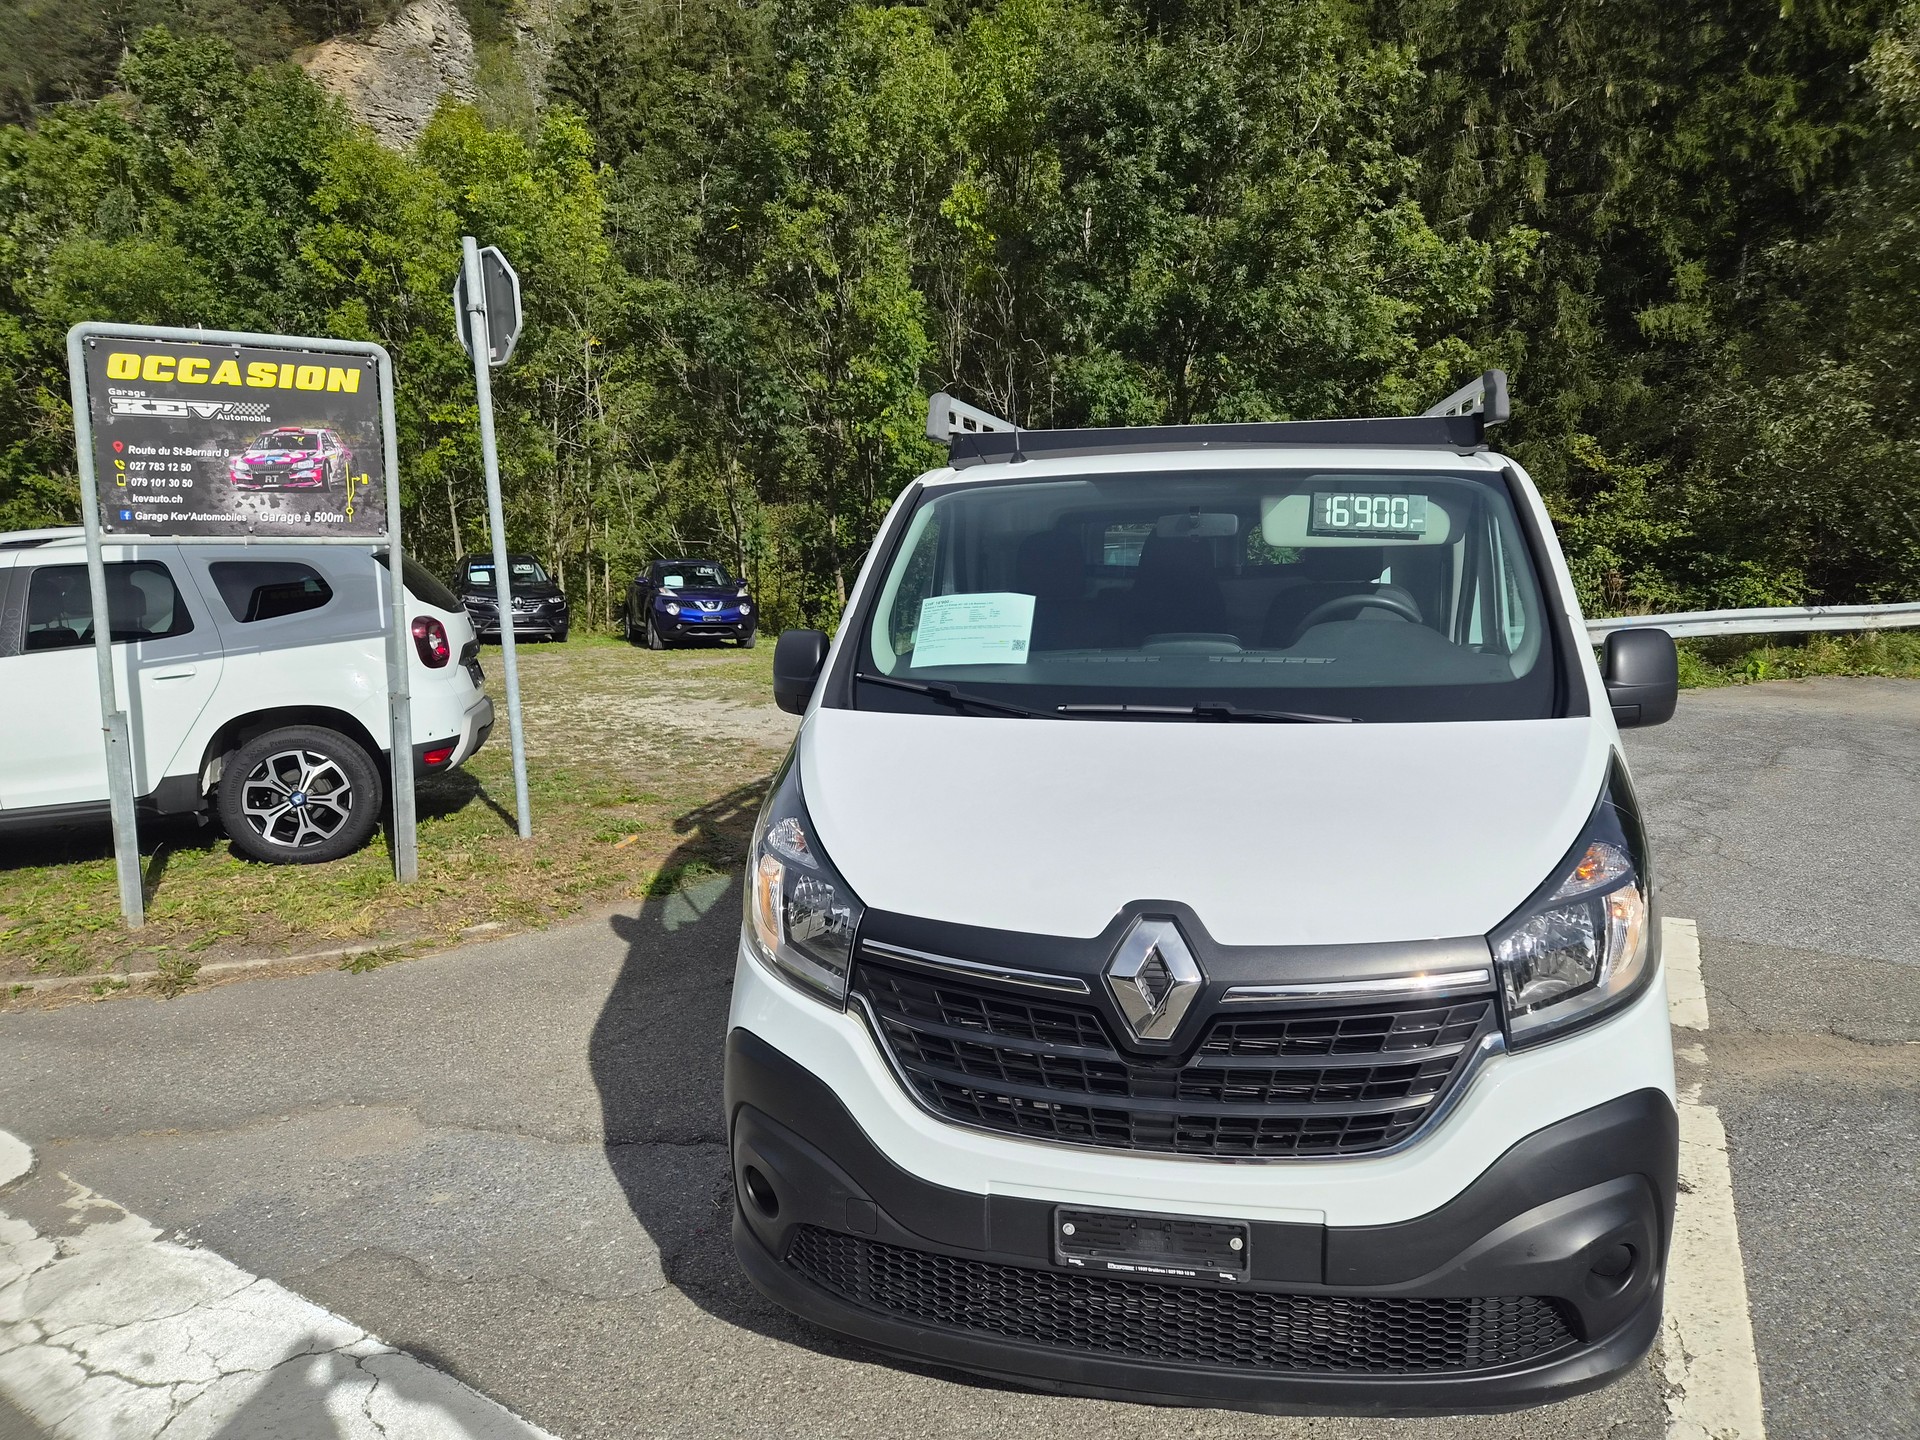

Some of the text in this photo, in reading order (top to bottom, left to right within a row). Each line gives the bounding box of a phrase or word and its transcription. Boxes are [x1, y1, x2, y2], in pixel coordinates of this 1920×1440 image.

[106, 353, 360, 393] OCCASION
[108, 388, 146, 398] Garage
[217, 413, 272, 423] Automobile
[128, 445, 230, 457] Route du St-Bernard 8
[129, 461, 192, 472] 027 783 12 50
[130, 478, 193, 488] 079 101 30 50
[132, 494, 184, 504] kevauto.ch
[134, 512, 247, 523] Garage Kev'Automobiles
[260, 511, 345, 525] Garage à 500m
